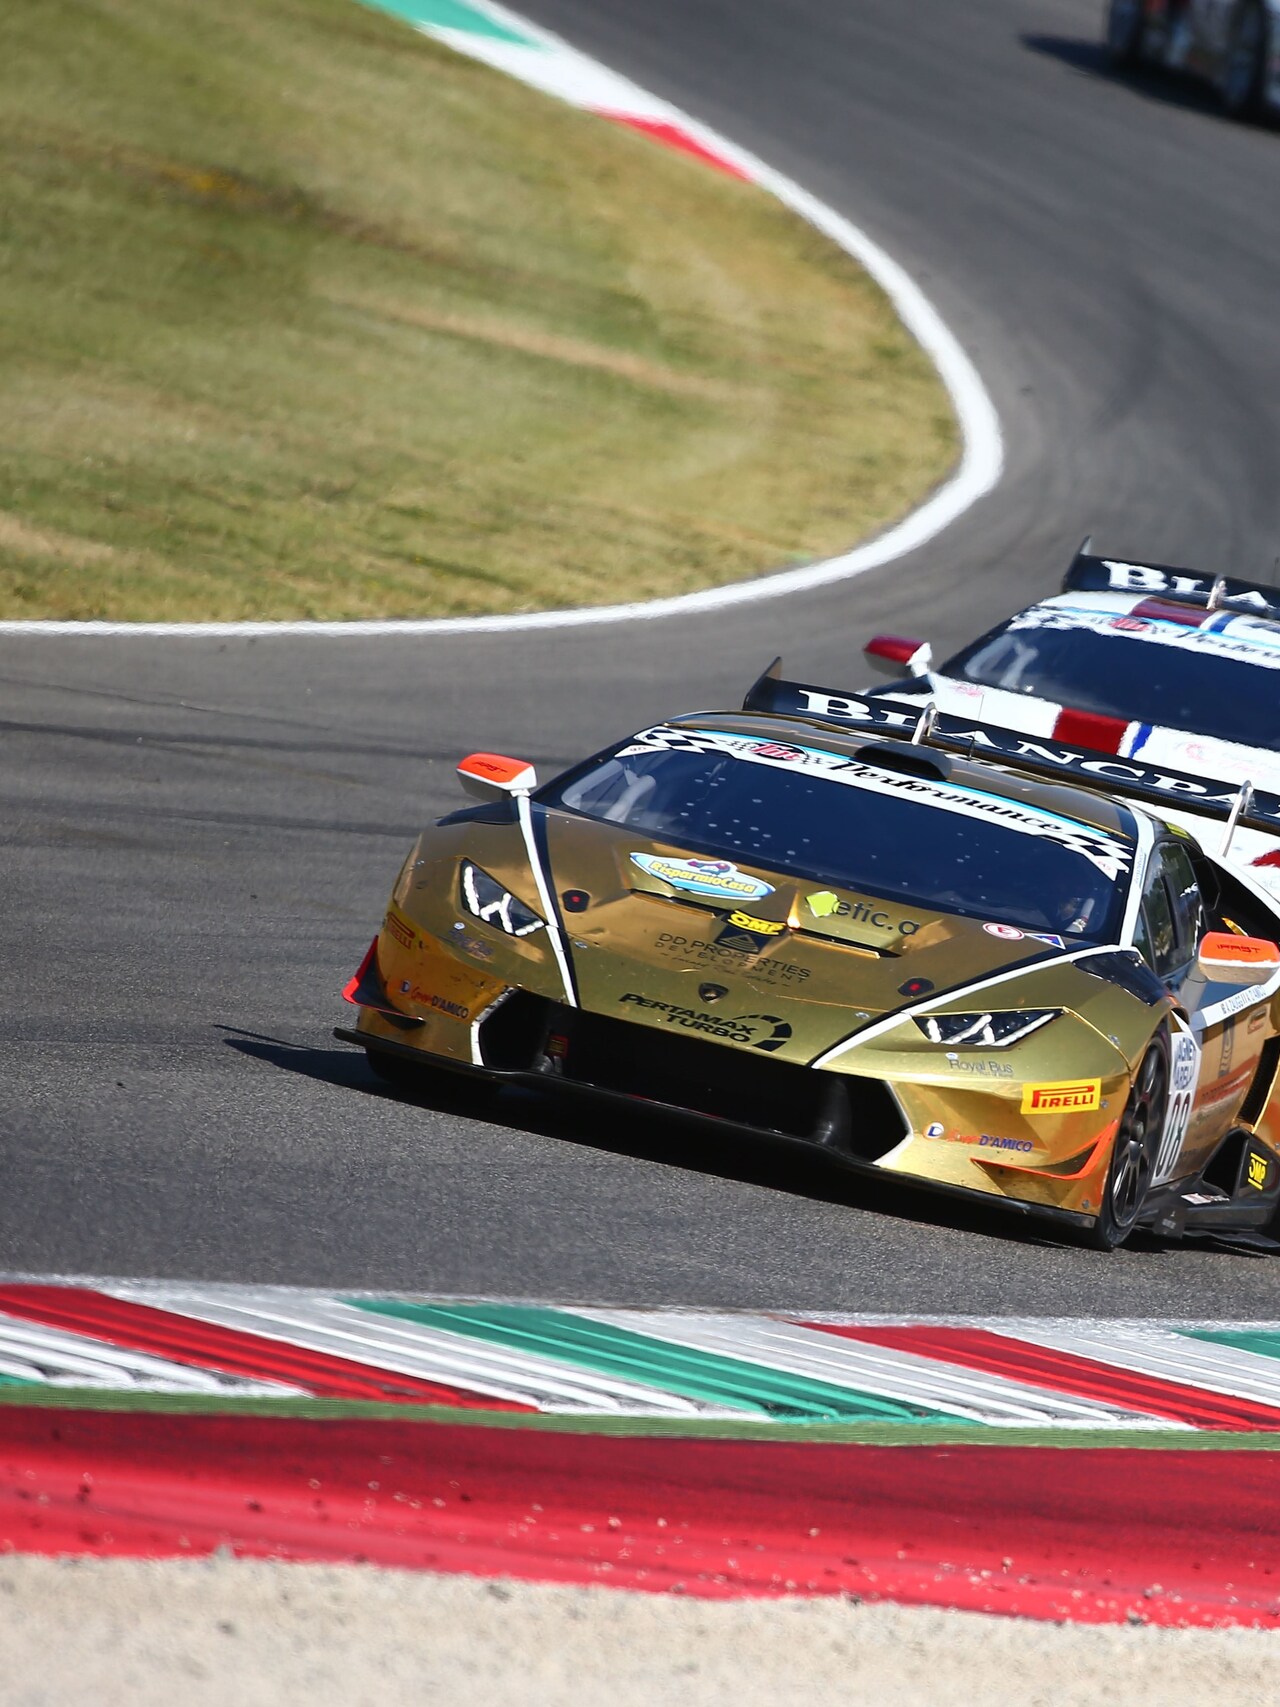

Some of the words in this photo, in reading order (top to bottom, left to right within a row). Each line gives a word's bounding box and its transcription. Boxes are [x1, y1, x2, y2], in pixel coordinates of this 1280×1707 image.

[828, 760, 1063, 832] Performance
[648, 860, 757, 894] RisparmioCasa
[729, 913, 786, 934] OMP
[654, 942, 808, 984] DEVELOPMENT
[659, 933, 687, 946] DD
[691, 940, 812, 979] PROPERTIES
[619, 993, 758, 1035] PERTAMAX
[666, 1013, 752, 1043] TURBO
[948, 1058, 986, 1073] Royal
[988, 1060, 1014, 1074] Bus
[1031, 1085, 1096, 1108] PIRELLI
[978, 1134, 1034, 1153] D'AMICO
[1248, 1158, 1267, 1185] OMP
